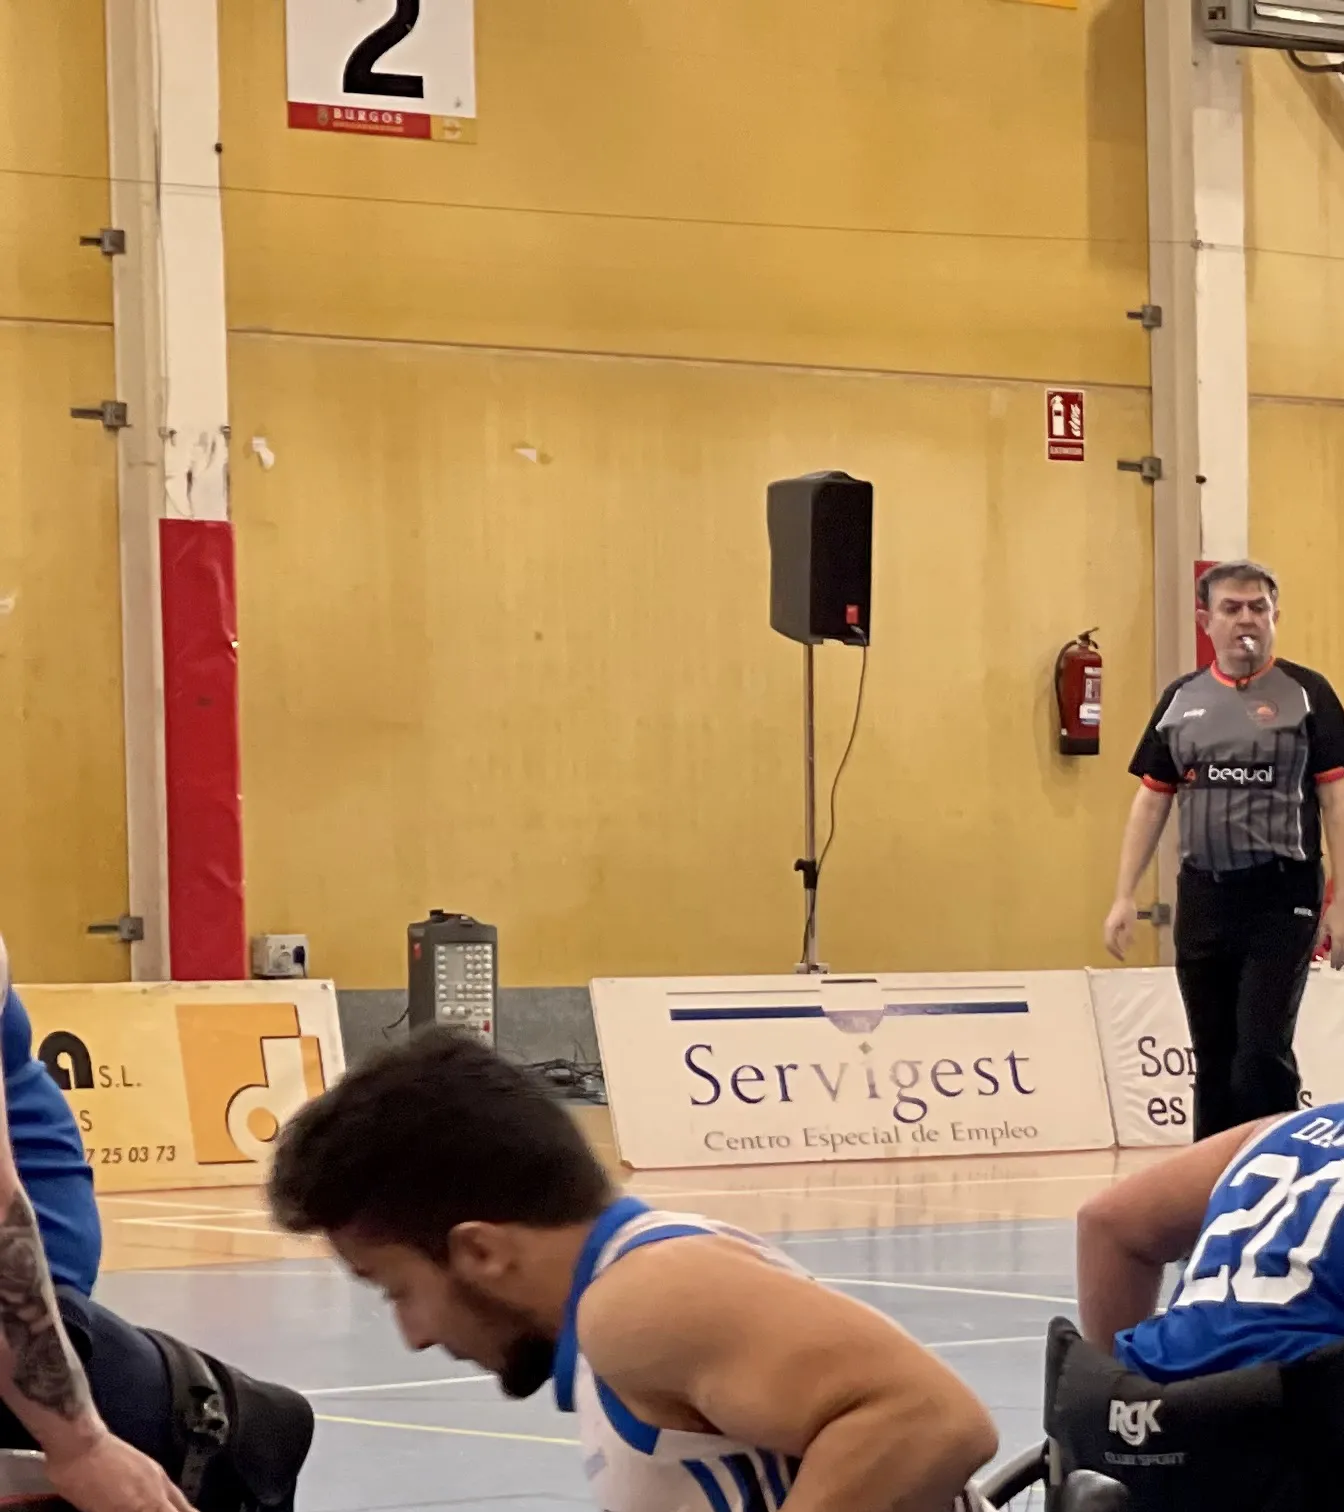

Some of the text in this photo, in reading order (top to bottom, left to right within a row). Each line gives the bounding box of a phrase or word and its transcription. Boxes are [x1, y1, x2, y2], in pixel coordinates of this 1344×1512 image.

[333, 107, 404, 124] BURGOS
[1208, 765, 1273, 784] bequal
[99, 1065, 142, 1088] S.L.
[684, 1043, 1036, 1123] Servigest
[1147, 1096, 1187, 1126] es
[704, 1120, 1038, 1152] Centro Especial de Empleo
[101, 1149, 122, 1164] 25
[128, 1147, 149, 1163] 03
[156, 1146, 176, 1162] 73
